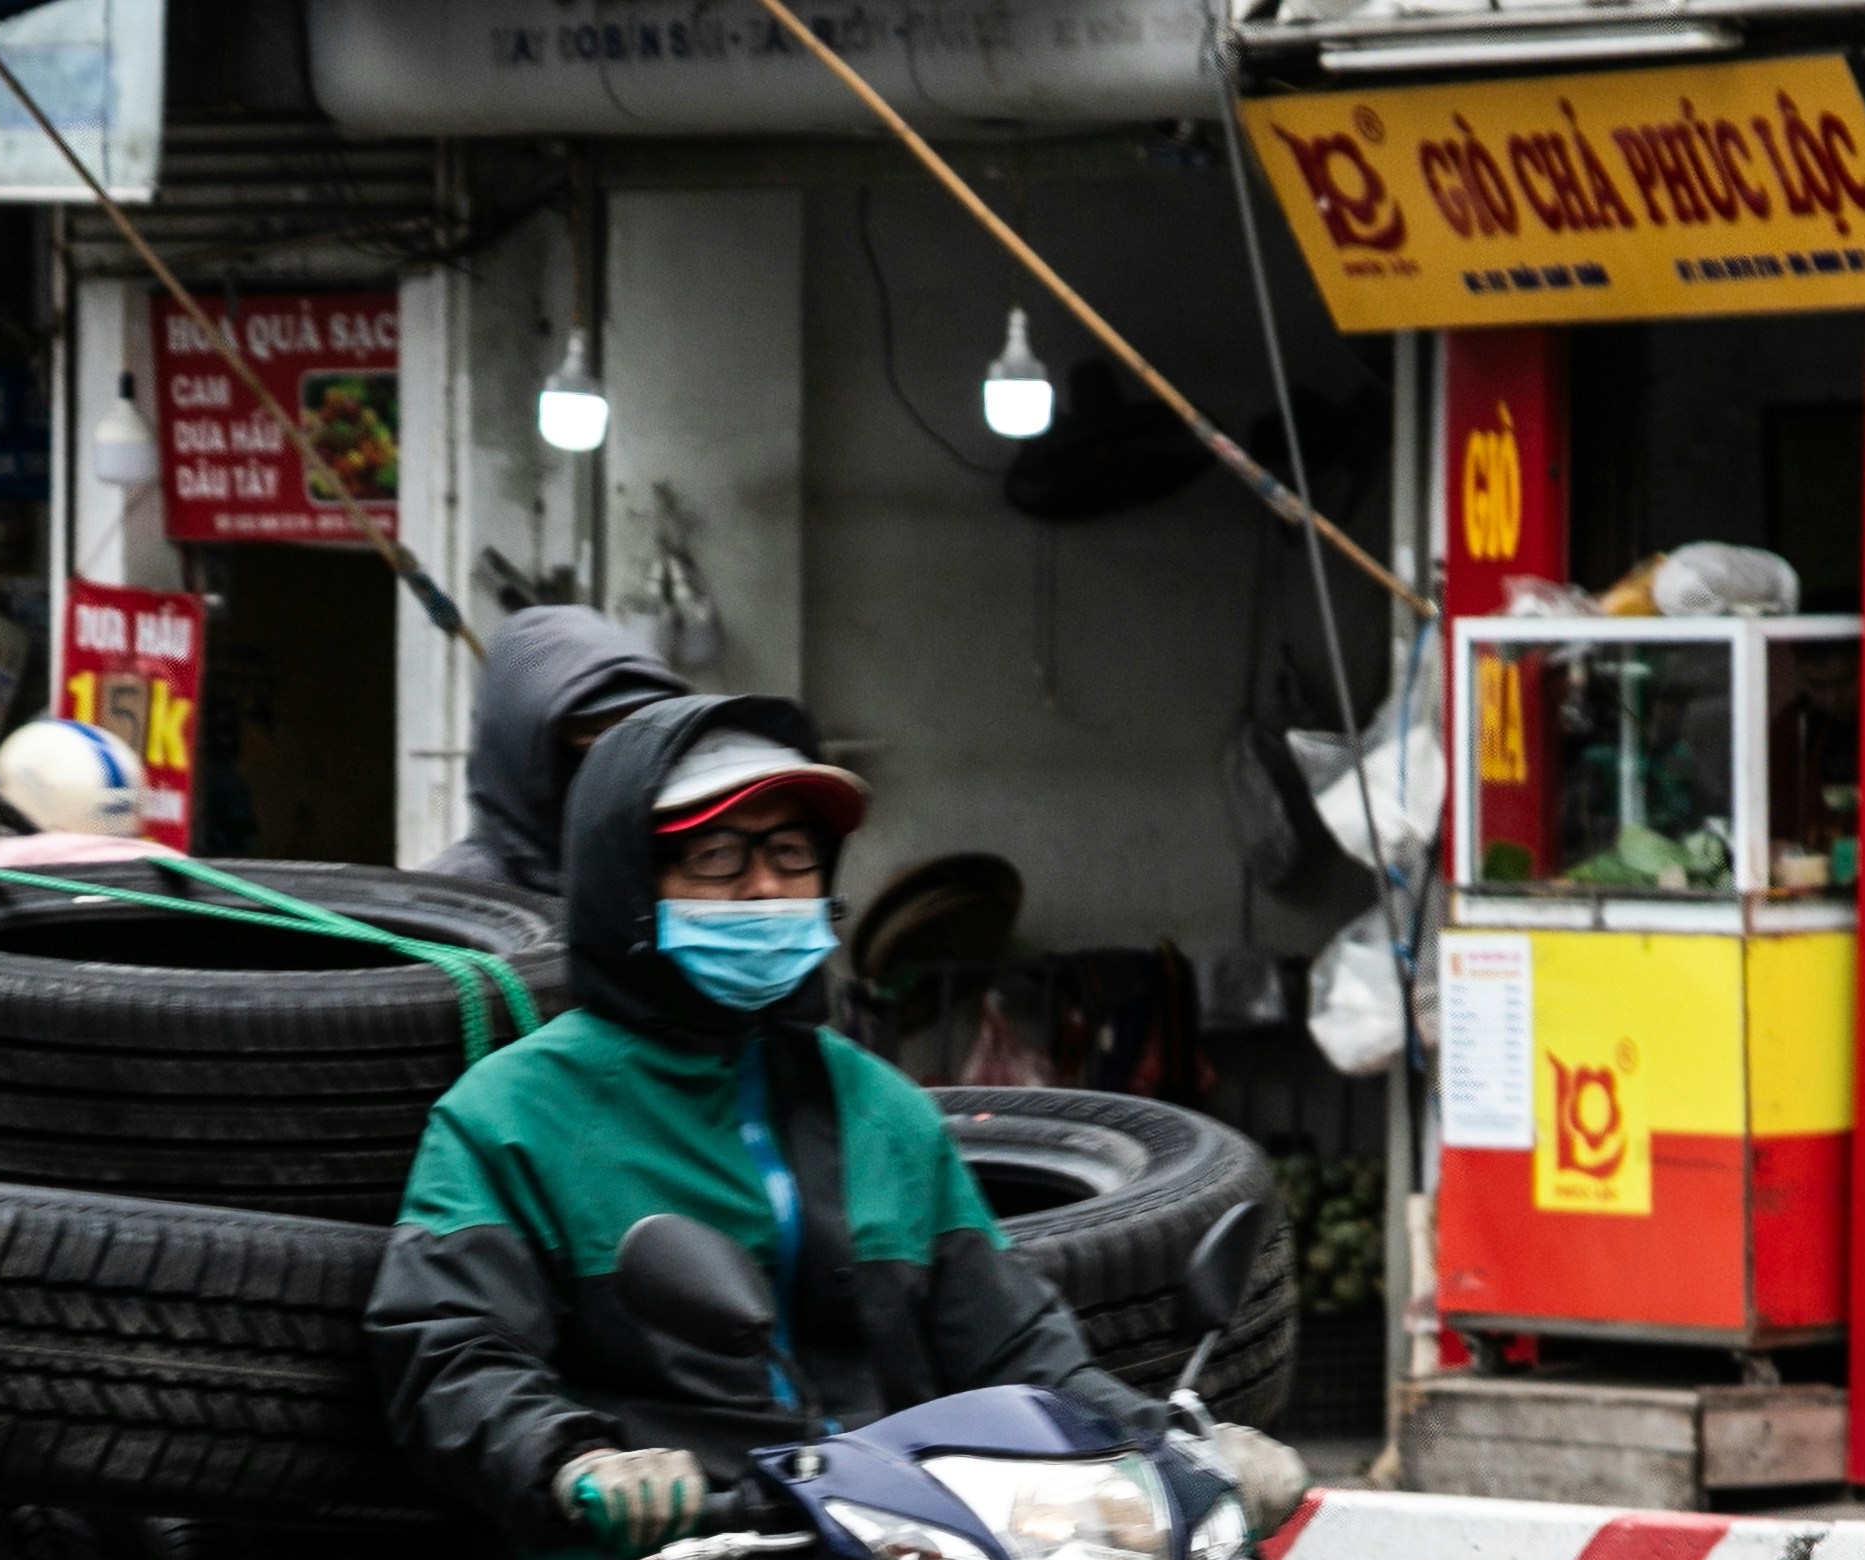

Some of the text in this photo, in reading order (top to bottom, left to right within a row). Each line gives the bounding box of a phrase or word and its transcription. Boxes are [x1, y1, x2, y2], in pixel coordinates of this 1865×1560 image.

[1417, 110, 1521, 239] GIÒ
[1507, 96, 1639, 235] CHẢ
[1611, 96, 1775, 227] PHÚC
[171, 372, 232, 409] CAM
[1462, 400, 1523, 561] GIÒ
